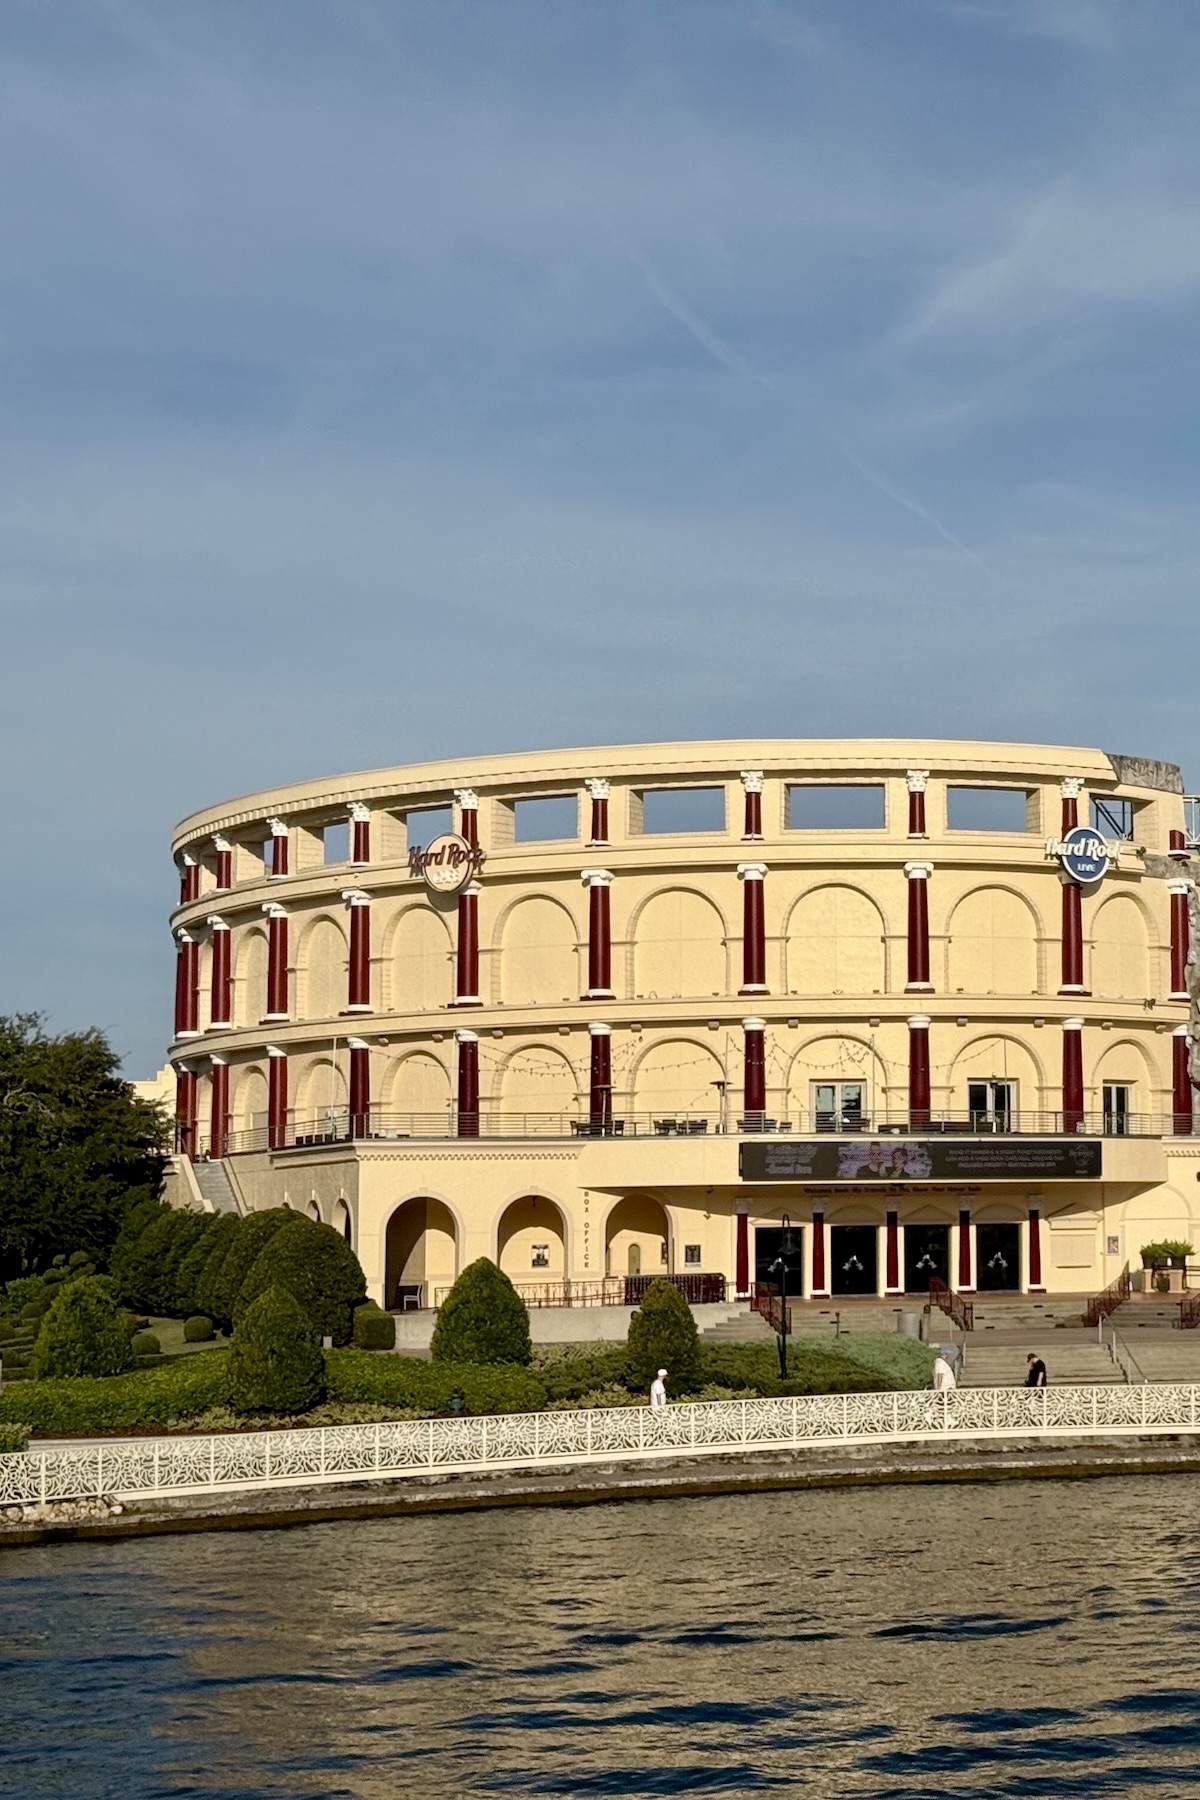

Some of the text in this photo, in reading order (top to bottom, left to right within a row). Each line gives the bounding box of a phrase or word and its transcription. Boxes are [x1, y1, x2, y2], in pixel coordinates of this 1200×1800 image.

[409, 843, 485, 870] Hard Rock
[1045, 838, 1124, 862] Hard Rock
[1077, 863, 1096, 872] LIVE
